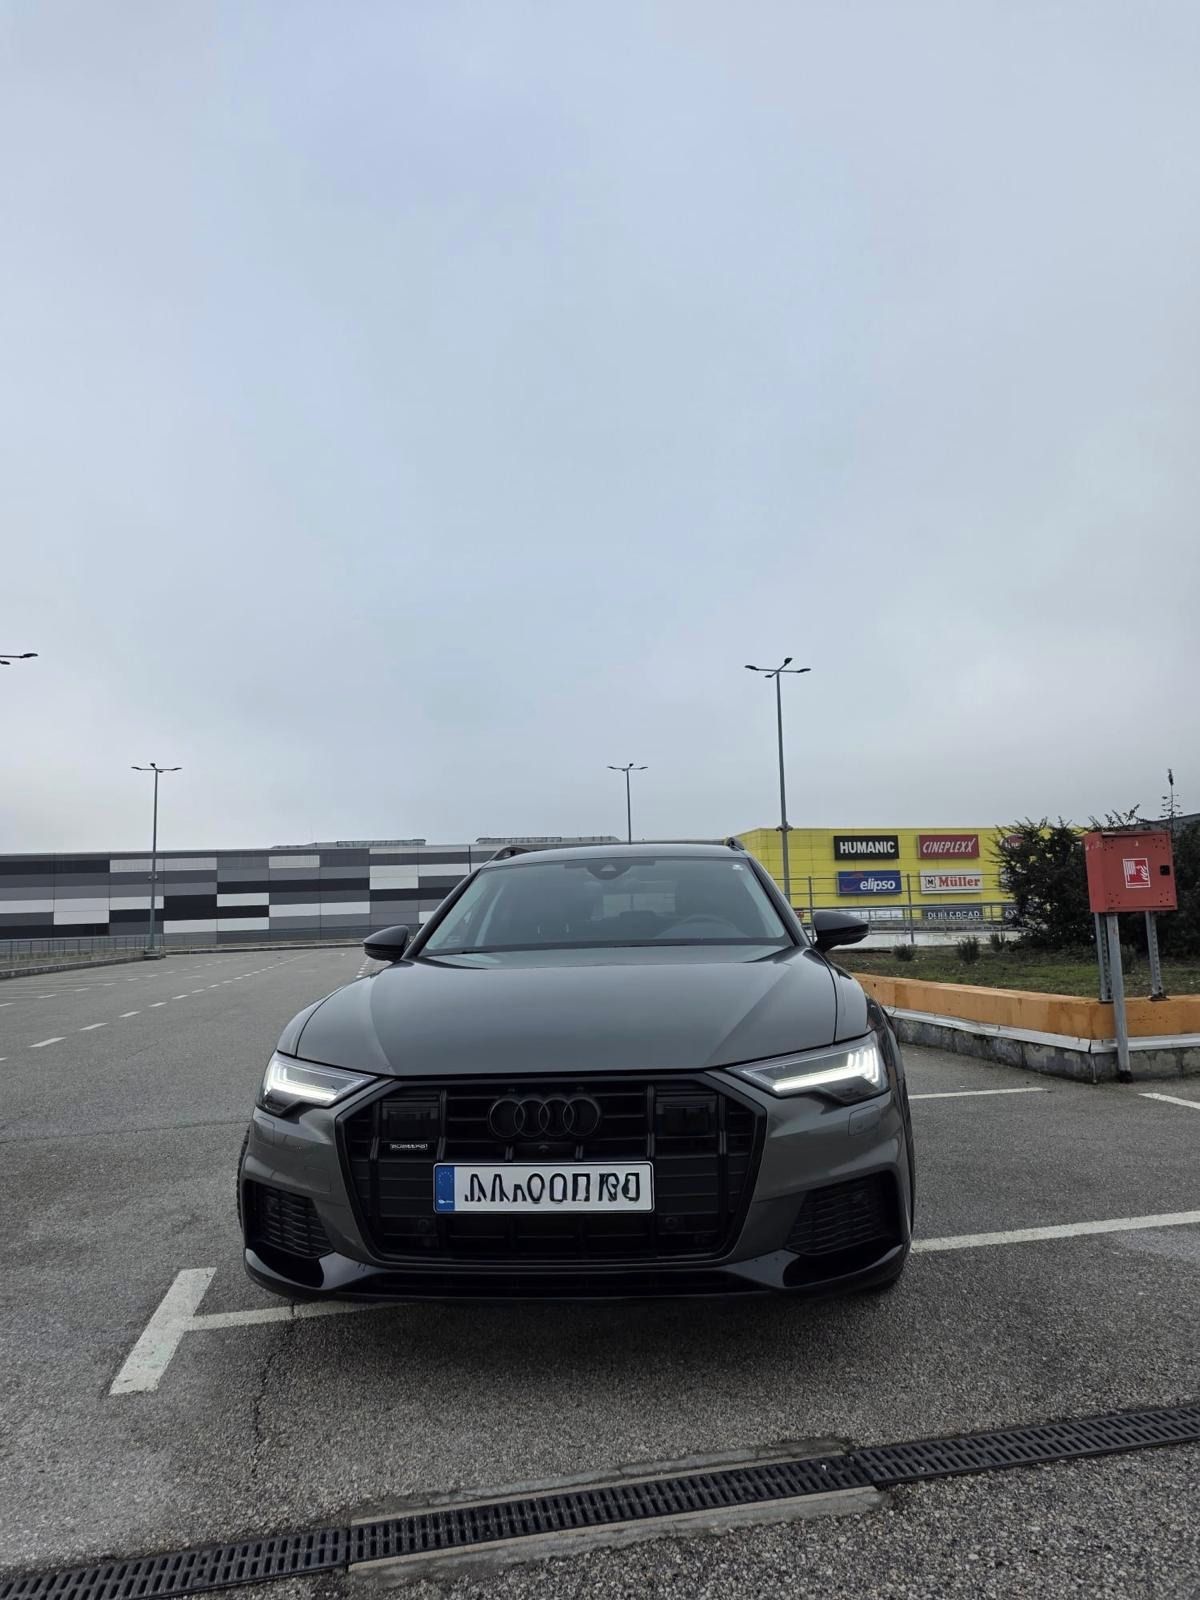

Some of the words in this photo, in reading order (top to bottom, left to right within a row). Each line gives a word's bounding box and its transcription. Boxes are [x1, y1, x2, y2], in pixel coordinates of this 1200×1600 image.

[840, 841, 895, 854] HUMANIC
[922, 838, 976, 853] CINEPLEXX
[860, 876, 896, 892] elipso
[939, 876, 980, 887] Müller
